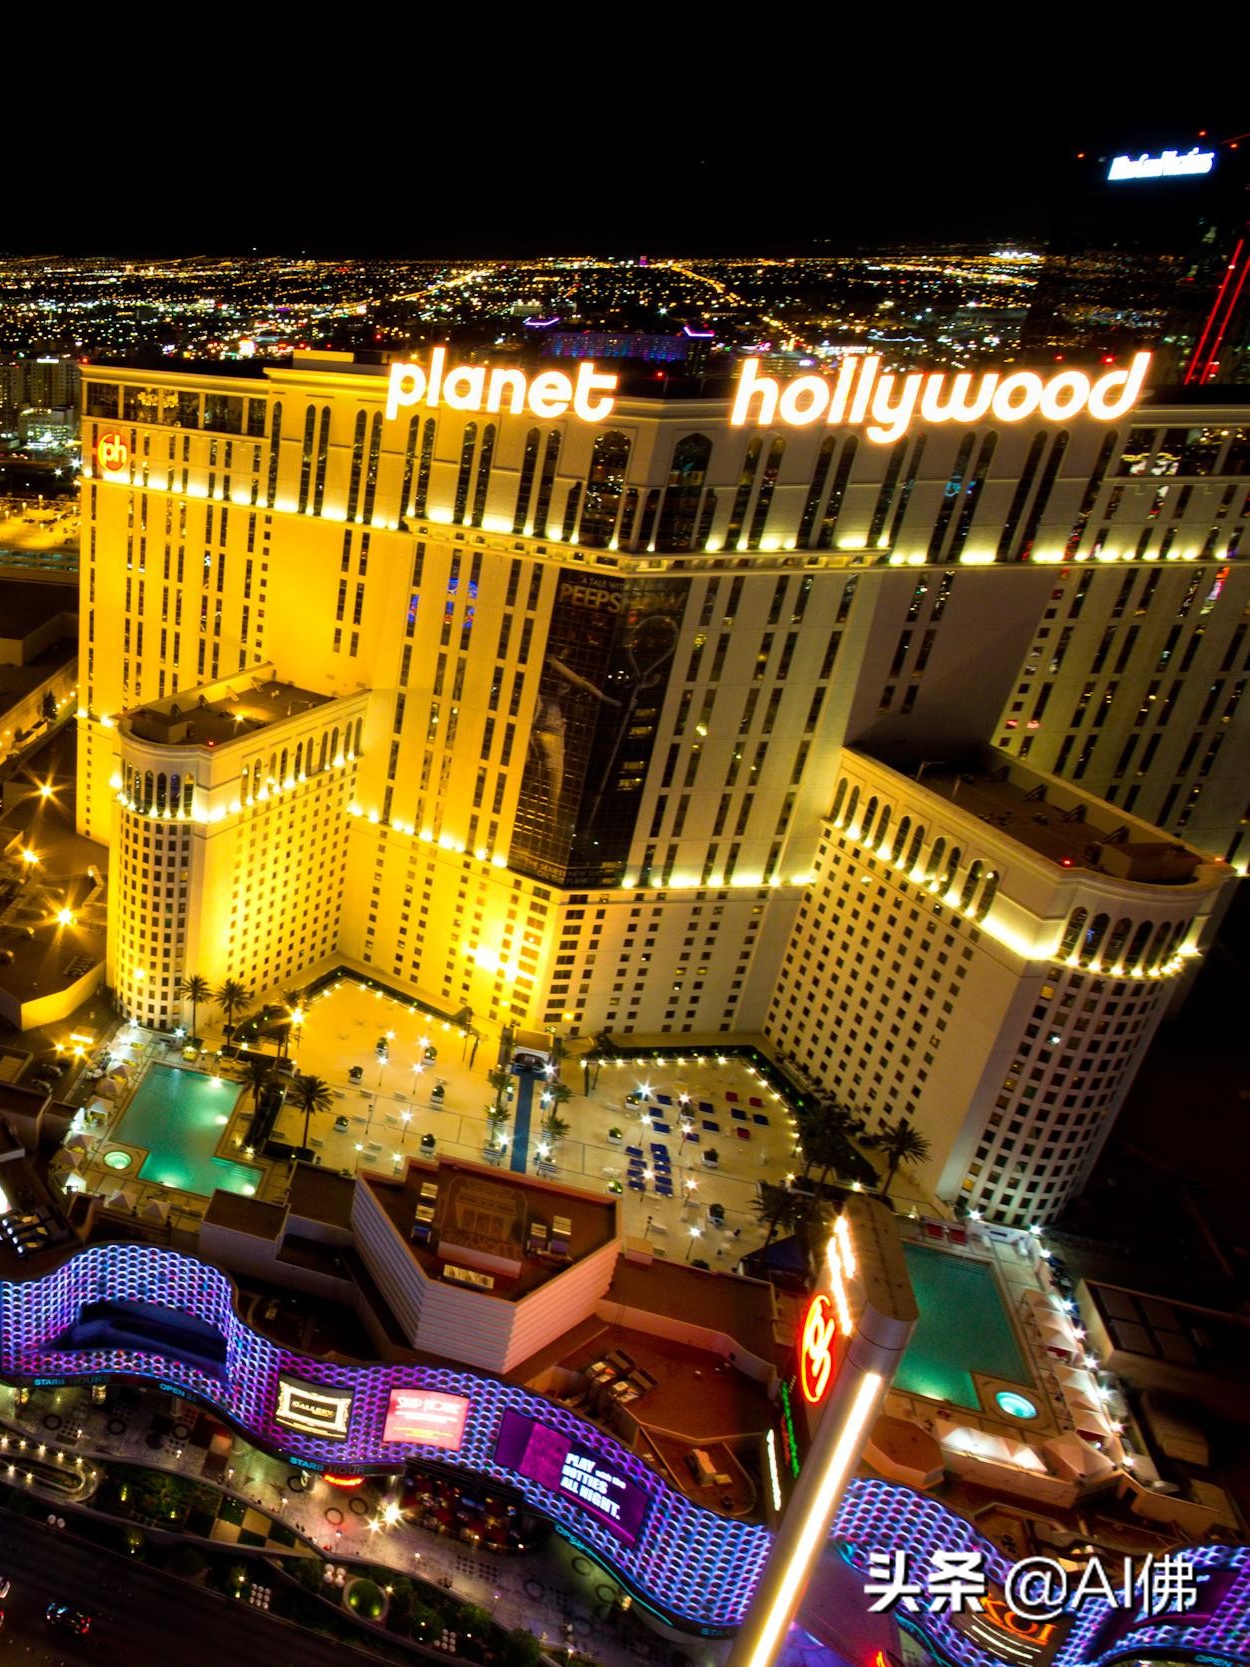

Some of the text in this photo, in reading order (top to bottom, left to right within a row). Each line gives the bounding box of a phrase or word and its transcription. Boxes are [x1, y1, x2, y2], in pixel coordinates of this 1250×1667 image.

[385, 347, 1152, 444] planet hollywood
[101, 434, 127, 465] ph
